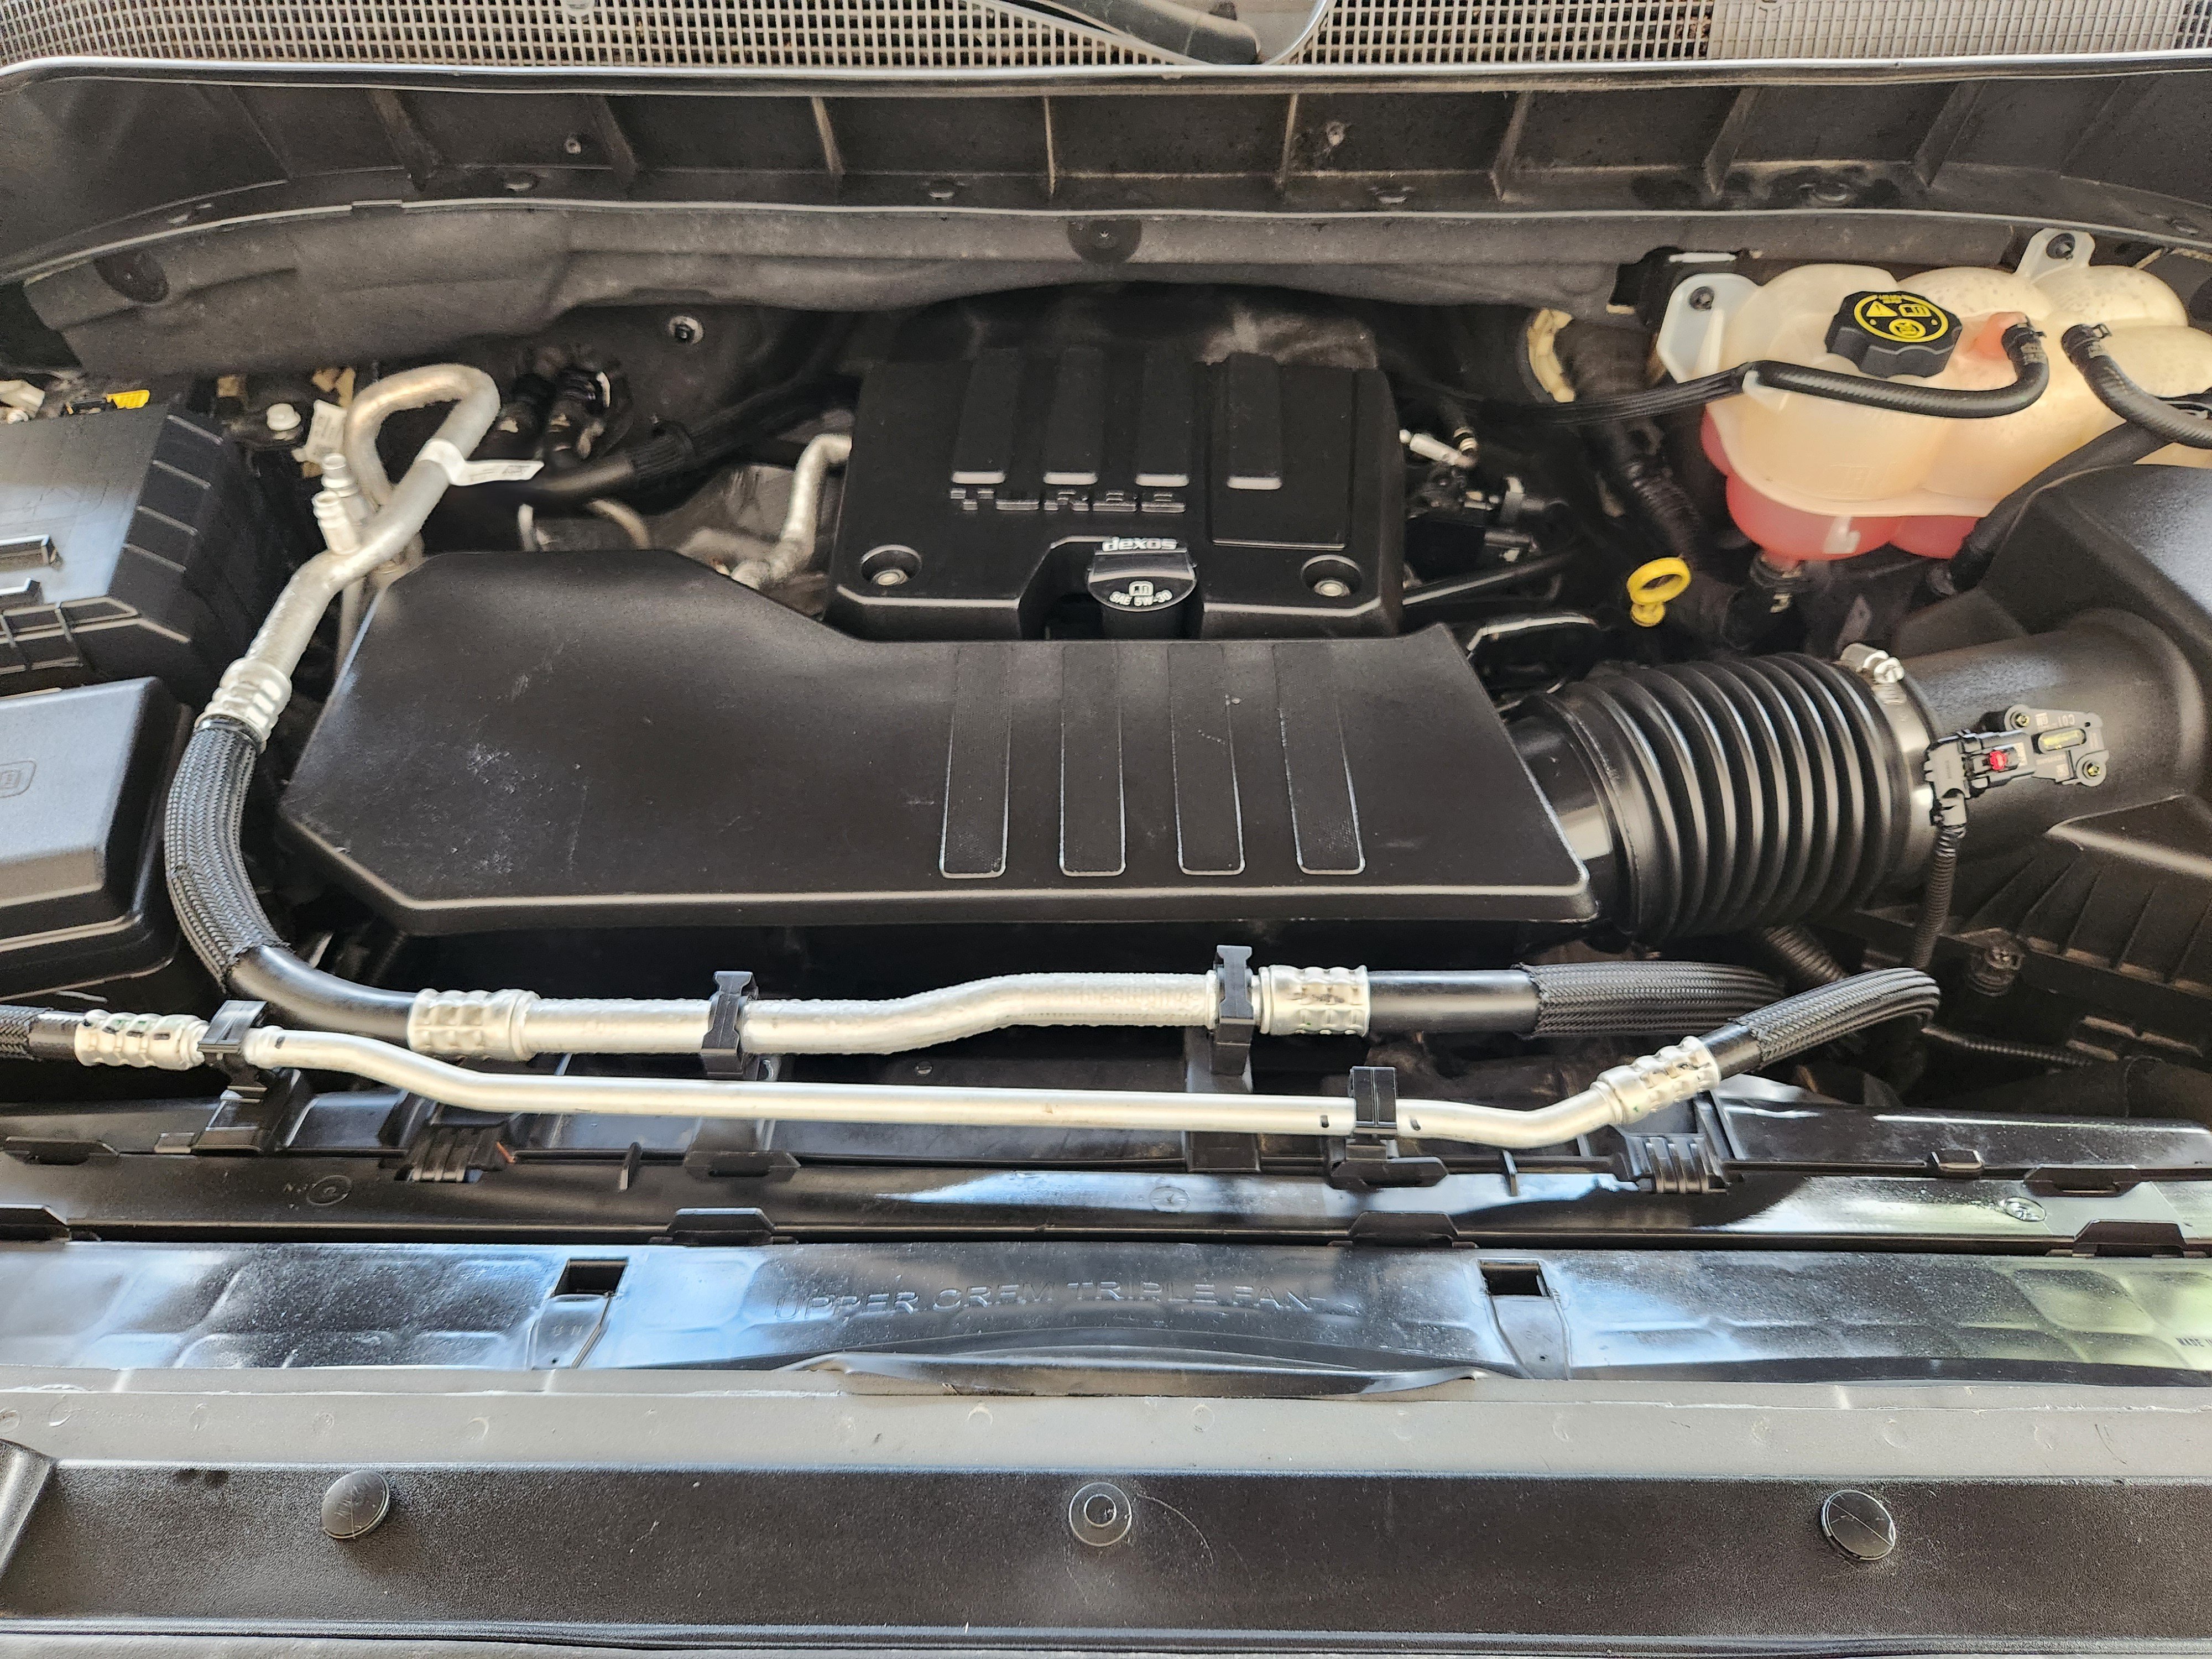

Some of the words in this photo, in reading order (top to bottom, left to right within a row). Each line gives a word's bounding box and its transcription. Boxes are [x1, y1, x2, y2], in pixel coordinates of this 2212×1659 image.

[1102, 536, 1178, 552] dexos
[1109, 591, 1133, 606] SAE
[1133, 589, 1173, 607] 5W-30
[774, 1291, 920, 1321] UPPER
[1067, 1281, 1218, 1304] TRIPLE
[1232, 1285, 1312, 1312] FAN
[2174, 1337, 2205, 1347] MADE
